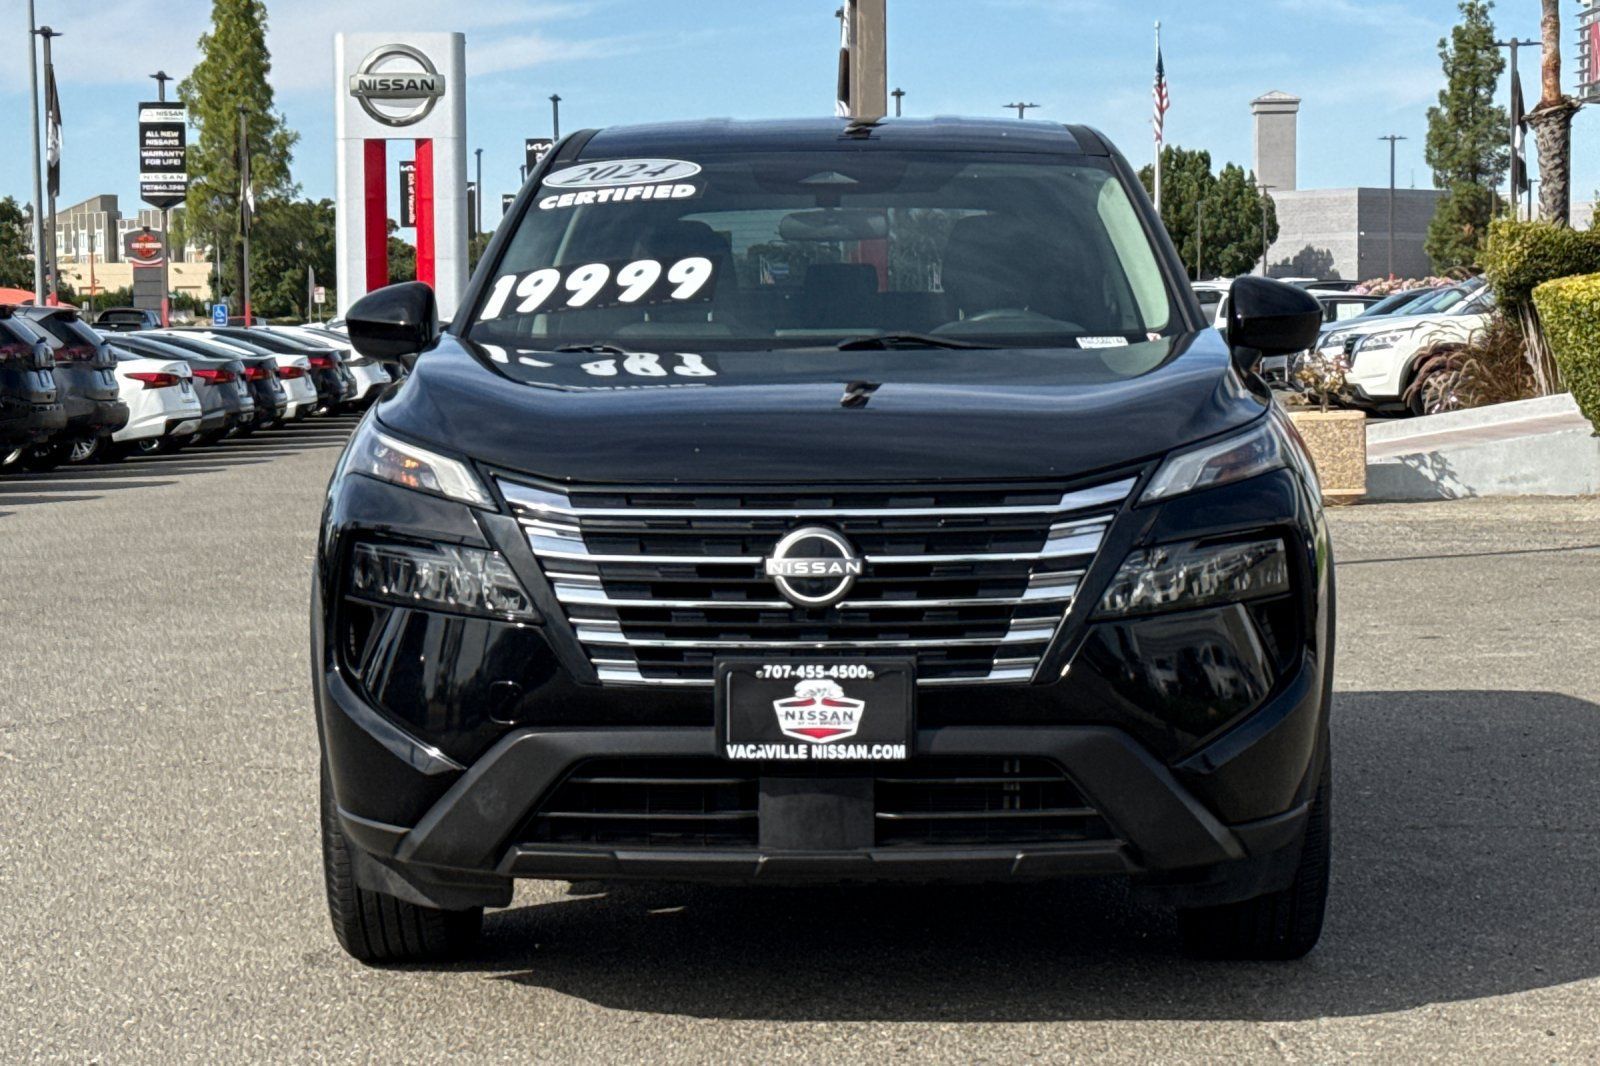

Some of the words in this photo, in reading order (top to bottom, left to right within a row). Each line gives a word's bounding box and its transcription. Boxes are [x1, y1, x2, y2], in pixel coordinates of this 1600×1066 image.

[358, 79, 435, 92] NISSAN
[141, 150, 185, 158] WARRANTY
[561, 162, 684, 184] 2024
[538, 184, 696, 210] CERTIFIED
[480, 256, 713, 321] 19999
[770, 562, 860, 574] NISSAN
[763, 664, 868, 679] 707-455-4500
[784, 710, 854, 722] NISSAN
[726, 744, 808, 760] VACAVILLE
[811, 744, 906, 760] NISSAN.COM
